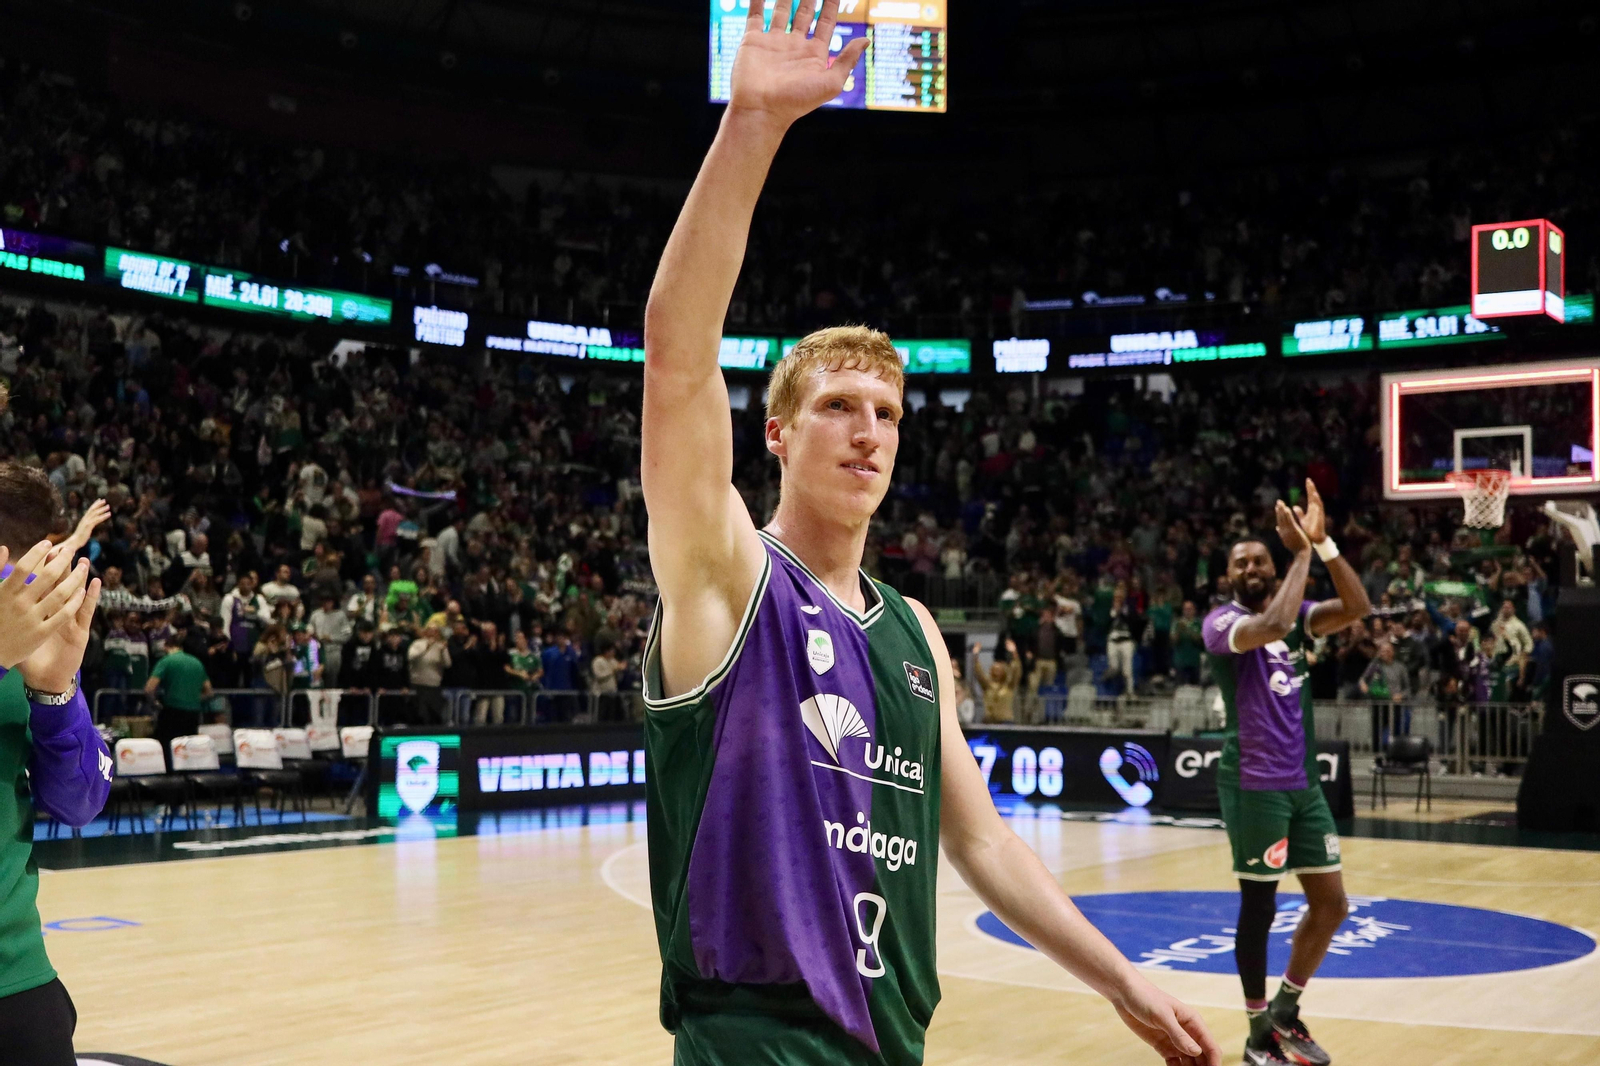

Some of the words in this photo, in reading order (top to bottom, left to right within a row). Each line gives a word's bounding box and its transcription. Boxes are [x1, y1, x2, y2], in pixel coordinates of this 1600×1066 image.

[1492, 227, 1530, 250] 0.0
[30, 257, 85, 281] BURSA
[239, 281, 279, 308] 24.01
[527, 320, 612, 347] UNICAJA
[1415, 315, 1458, 338] 24.01
[477, 753, 585, 792] VENTA
[589, 750, 629, 787] DE
[1012, 746, 1064, 797] 08
[853, 892, 887, 978] 9
